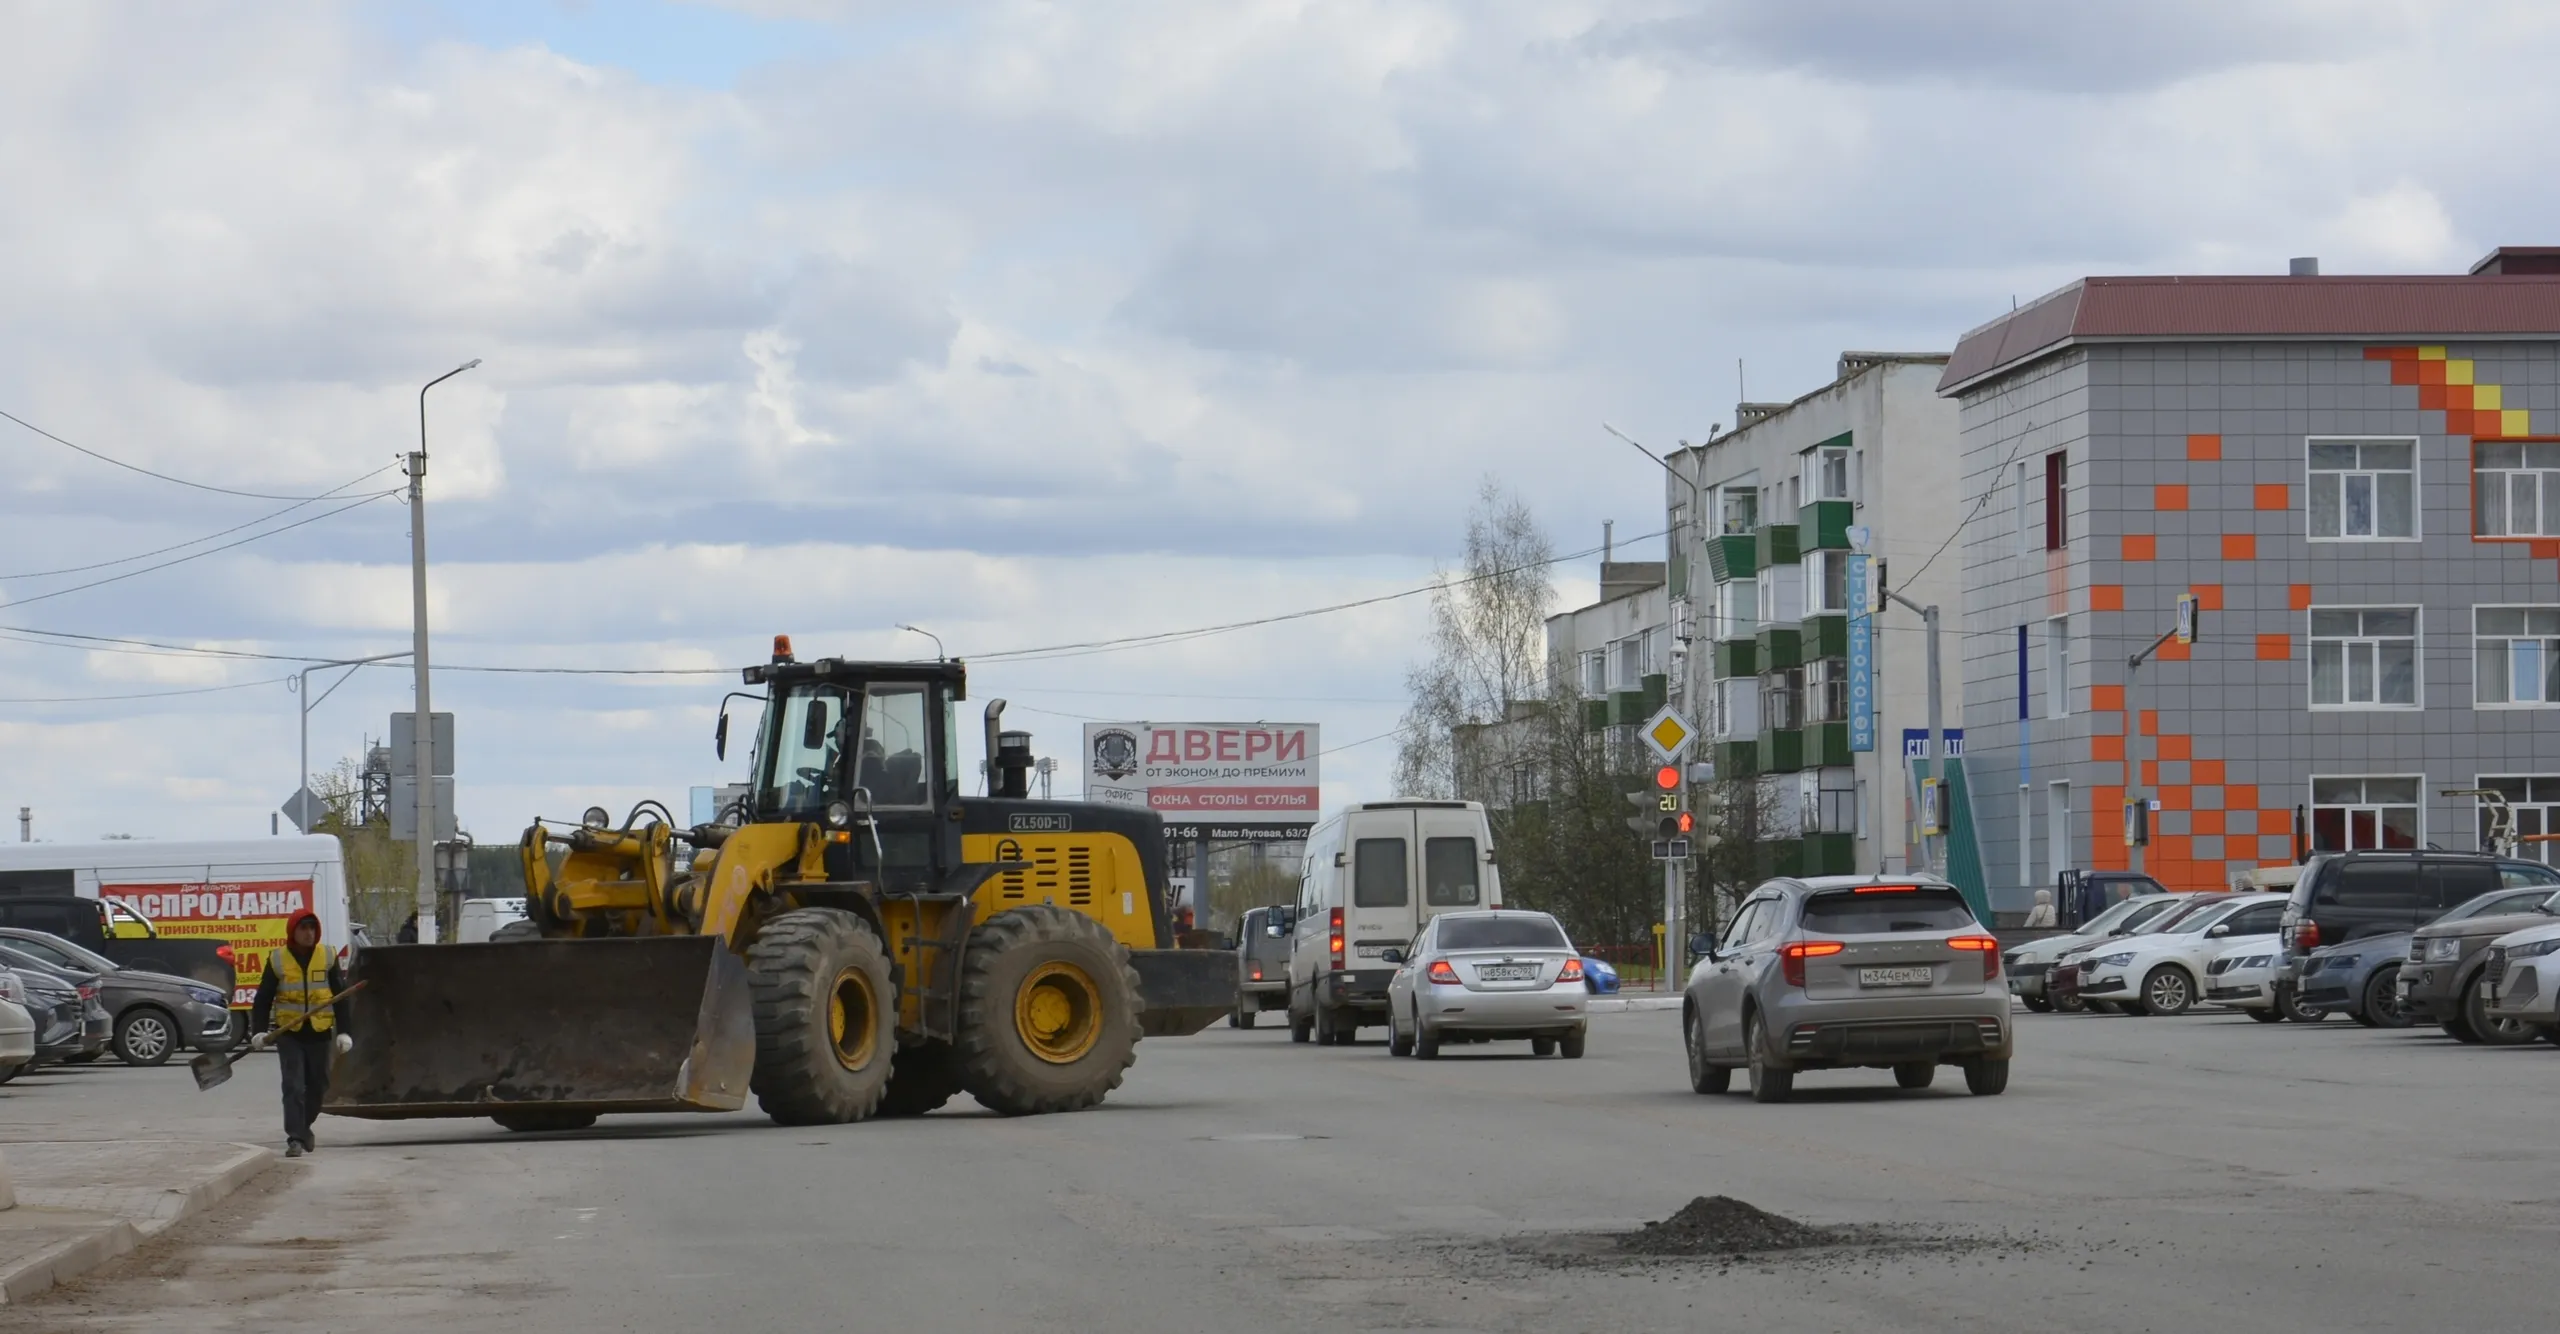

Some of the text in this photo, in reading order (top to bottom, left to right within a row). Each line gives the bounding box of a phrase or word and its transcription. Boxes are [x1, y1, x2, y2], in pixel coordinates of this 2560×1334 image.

[1145, 729, 1306, 765] ДВЕРИ
[1145, 768, 1162, 777] ОТ
[1165, 768, 1219, 777] ЭКОНОМ
[1222, 768, 1239, 779] ДО
[1243, 767, 1306, 777] ПРЕМИУМ
[1104, 789, 1134, 801] ОФИС
[1151, 794, 1307, 806] ОКНА СТОЛЫ СТУЛЬЯ
[1659, 794, 1677, 811] 20
[1211, 828, 1239, 838] Мало
[1240, 828, 1285, 841] Луговая,
[157, 923, 258, 935] трикотажных
